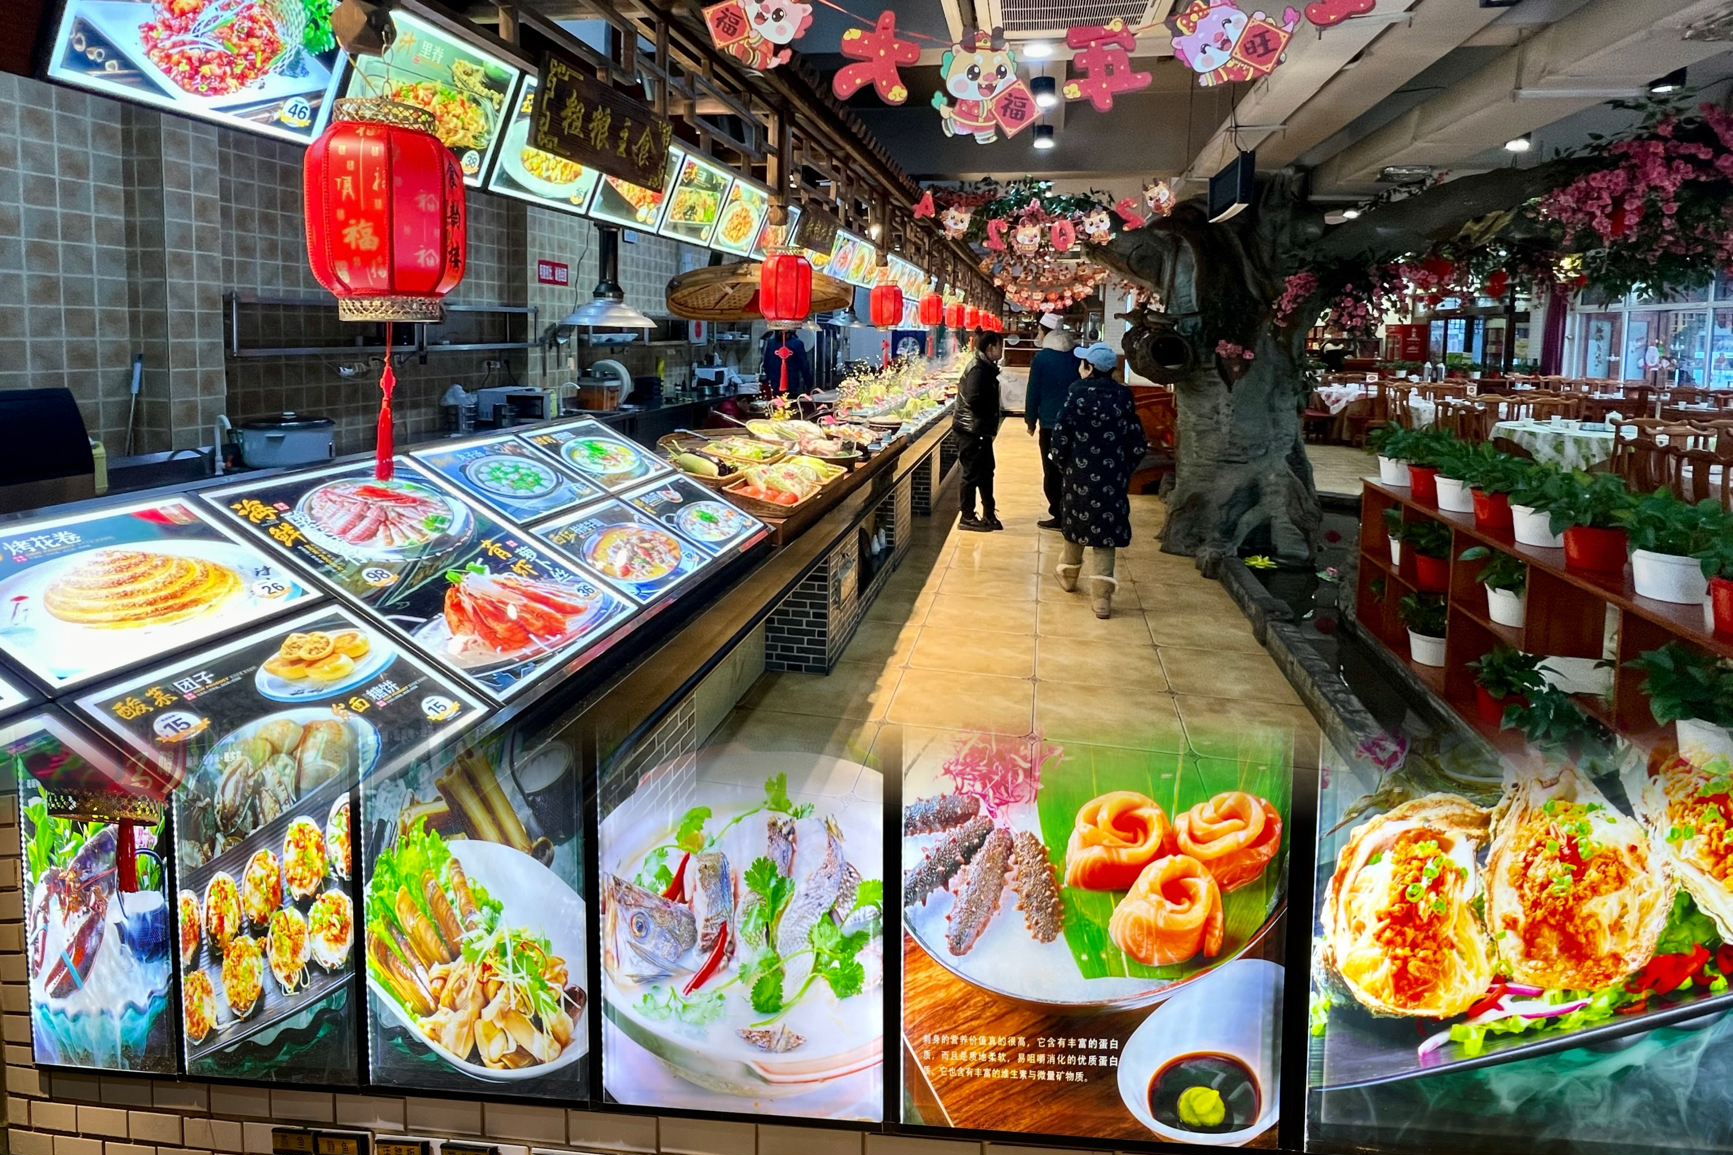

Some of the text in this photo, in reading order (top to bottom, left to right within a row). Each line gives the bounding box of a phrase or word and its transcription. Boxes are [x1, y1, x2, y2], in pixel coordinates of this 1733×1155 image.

[715, 7, 744, 38] 福
[1243, 31, 1280, 58] 旺
[832, 10, 921, 106] 大
[288, 104, 309, 122] 46
[1000, 93, 1029, 121] 福
[561, 89, 655, 168] 粗粮主食
[466, 154, 478, 169] 38
[342, 218, 379, 251] 福
[3, 531, 82, 557] 烤花卷
[365, 568, 390, 583] 98
[515, 546, 574, 584] 萝卜丝
[262, 582, 285, 594] 26
[576, 586, 595, 597] 36
[173, 671, 214, 694] 团子
[112, 686, 178, 720] 酸菜
[428, 701, 447, 715] 15
[162, 718, 192, 735] 15
